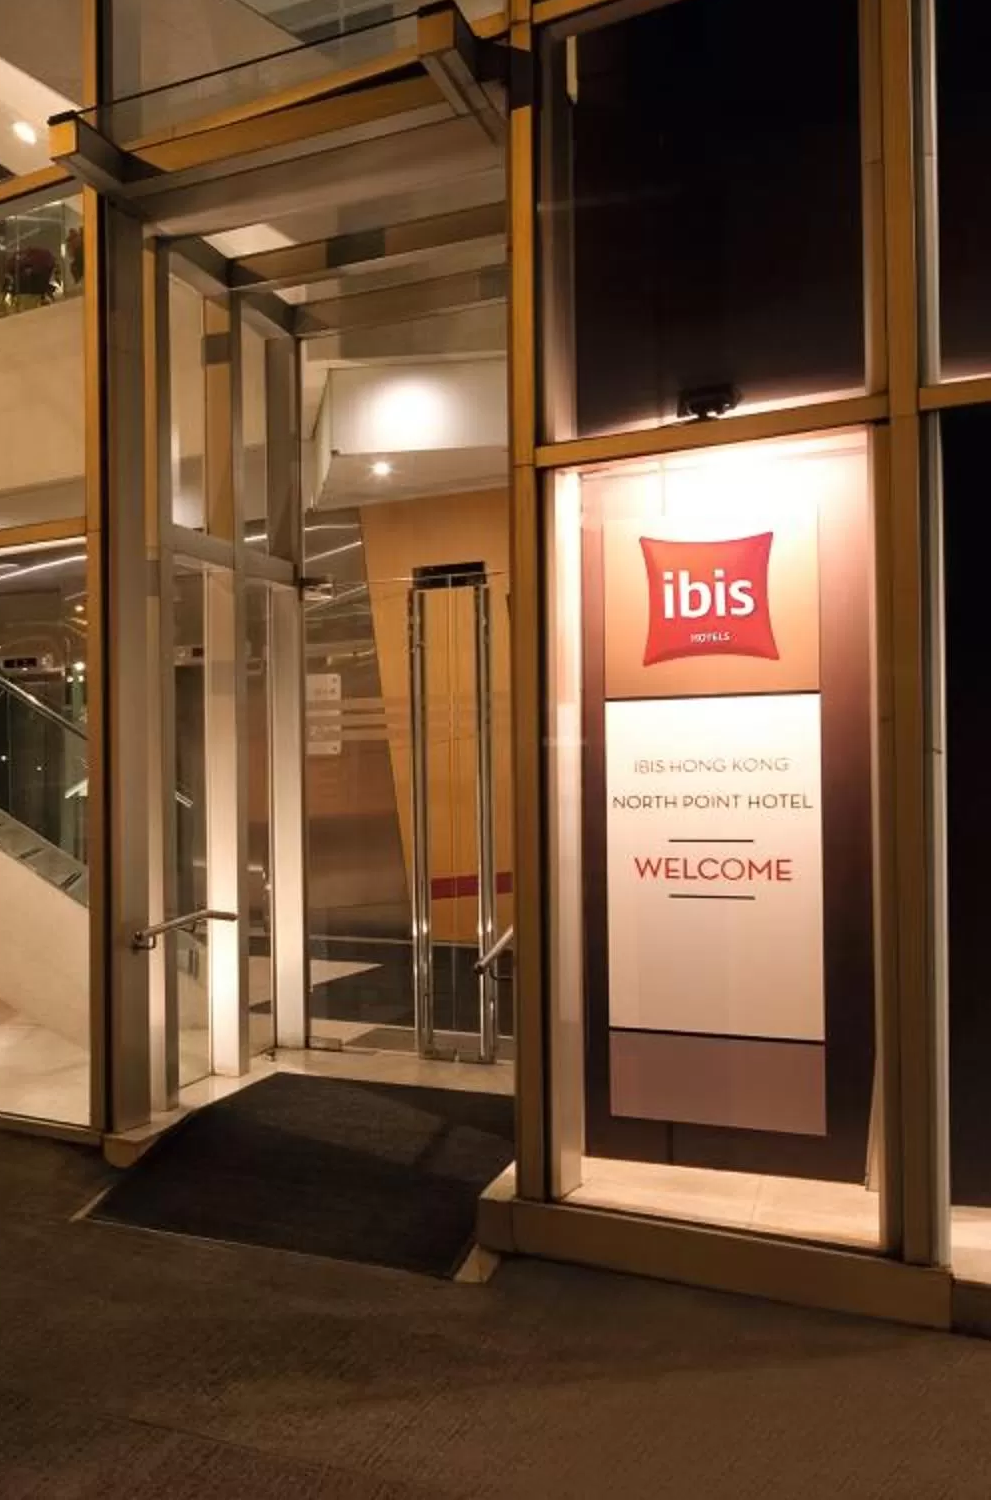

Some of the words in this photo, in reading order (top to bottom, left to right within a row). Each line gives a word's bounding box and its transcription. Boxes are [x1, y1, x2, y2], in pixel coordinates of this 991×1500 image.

[662, 567, 755, 620] ibis
[690, 631, 731, 644] HOTELS
[634, 759, 666, 775] IBIS
[669, 758, 727, 774] HONG
[732, 757, 790, 773] KONG
[612, 795, 678, 810] NORTH
[682, 794, 742, 809] POINT
[747, 793, 813, 809] HOTEL
[634, 857, 793, 881] WELCOME
